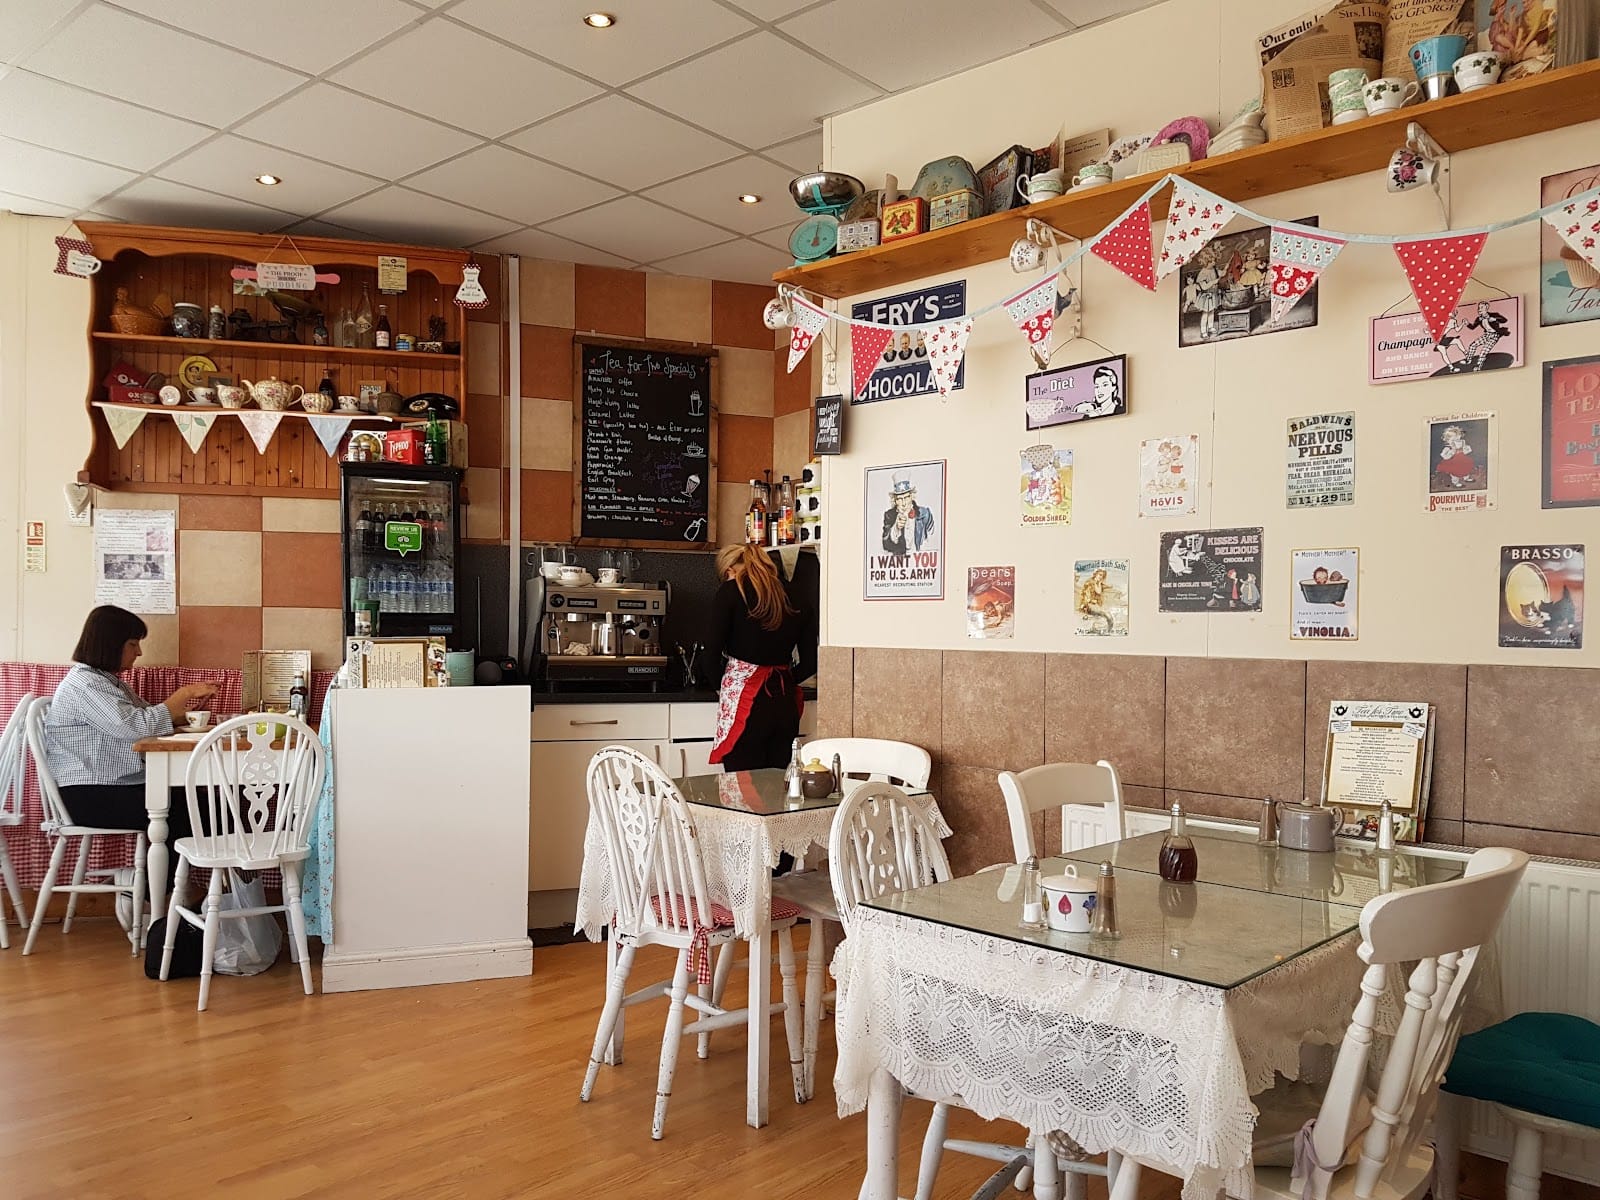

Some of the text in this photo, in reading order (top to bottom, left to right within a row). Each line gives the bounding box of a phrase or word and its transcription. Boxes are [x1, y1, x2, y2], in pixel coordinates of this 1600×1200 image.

[1259, 32, 1284, 48] Our
[266, 281, 308, 289] PUDDING
[1377, 337, 1434, 351] Champagn
[600, 350, 696, 379] Tea for Two Specials
[856, 371, 944, 402] CHOCOLA
[1032, 376, 1074, 396] The Diet
[1557, 372, 1600, 401] LO
[127, 391, 141, 399] OX
[1566, 395, 1600, 417] TE
[1289, 415, 1353, 432] BALDWIN'S
[1287, 428, 1354, 448] NERVOUS
[1298, 443, 1344, 458] PILLS
[1429, 493, 1476, 512] BOURNVILLE
[1207, 535, 1259, 546] KISSES ARE
[1214, 546, 1259, 555] DELICIOUS
[1511, 548, 1573, 559] BRASSO
[870, 552, 937, 569] I WANT YOU
[870, 568, 937, 581] FOR U.S. ARMY
[1299, 627, 1350, 637] VINOLIA
